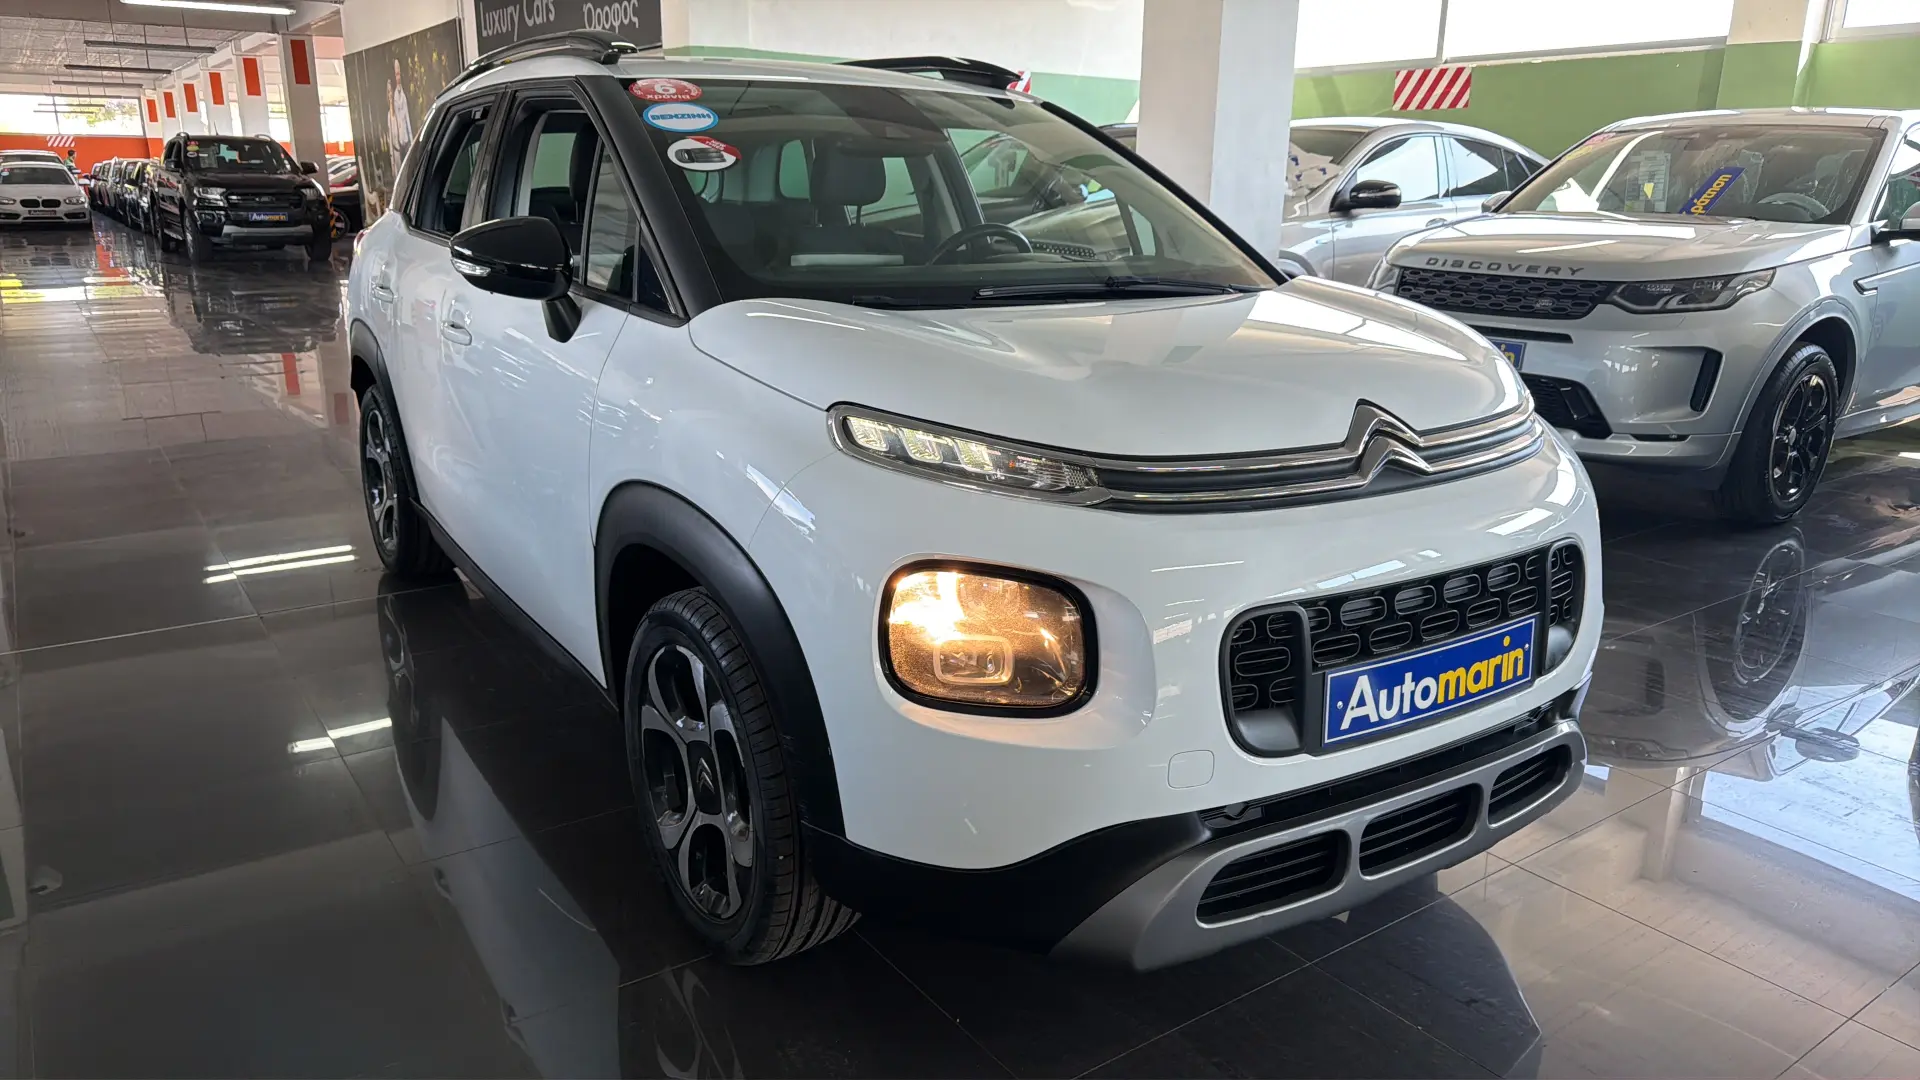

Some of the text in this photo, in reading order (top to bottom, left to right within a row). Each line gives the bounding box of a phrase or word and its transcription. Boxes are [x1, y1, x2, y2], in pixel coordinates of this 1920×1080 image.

[480, 0, 556, 42] Luxury Cars
[653, 82, 677, 95] 6
[1682, 173, 1734, 216] ράτηση
[251, 212, 286, 222] Automarin
[1425, 257, 1585, 277] DISCOVERY
[1340, 635, 1524, 731] Automarin
